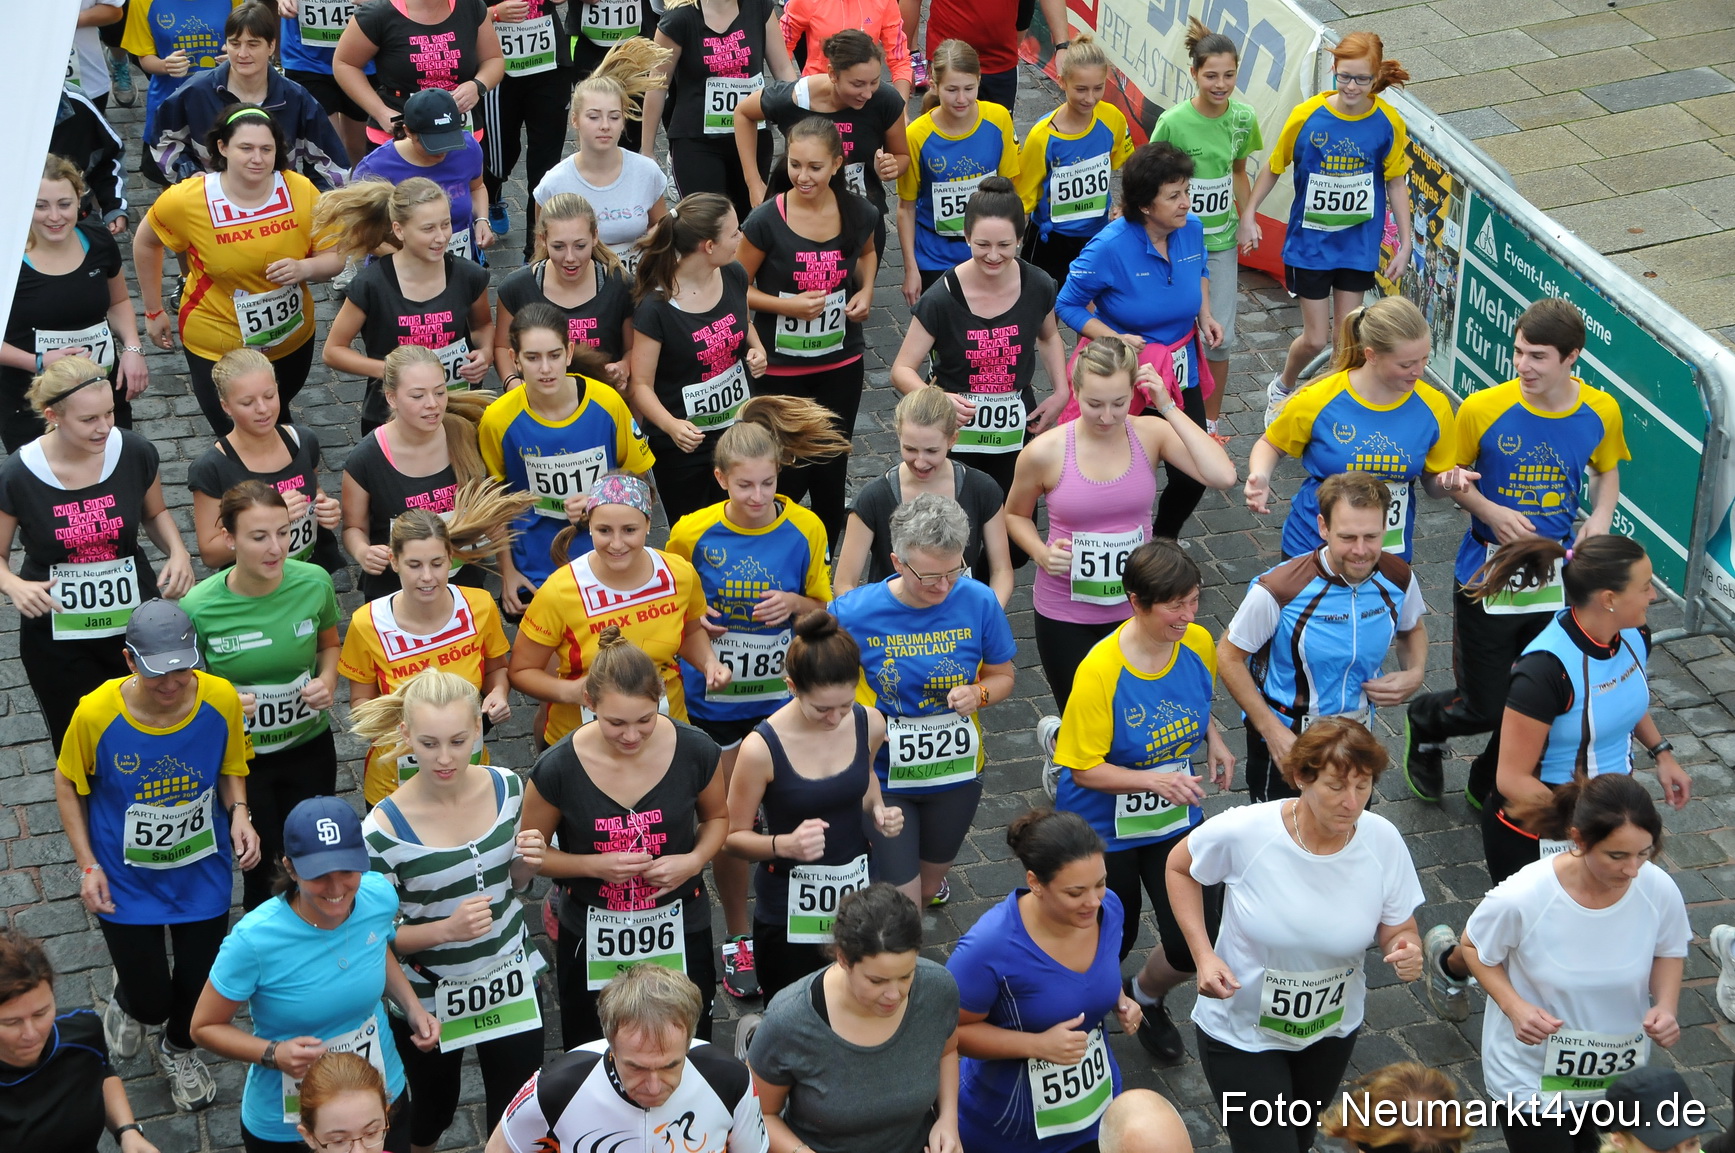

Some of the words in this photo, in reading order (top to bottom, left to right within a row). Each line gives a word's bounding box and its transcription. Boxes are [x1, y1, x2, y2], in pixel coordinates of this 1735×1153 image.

[588, 5, 636, 26] 5110
[516, 24, 544, 32] Neumarkt
[409, 36, 430, 45] WIR
[431, 31, 456, 43] SIND
[501, 30, 550, 56] 5175
[703, 38, 721, 47] WIR
[723, 30, 745, 44] SIND
[420, 42, 449, 53] ZWAR
[713, 41, 740, 54] ZWAR
[410, 52, 441, 63] NICHT
[444, 49, 461, 59] DIE
[510, 57, 543, 69] Angelina
[703, 52, 733, 65] NICHT
[736, 46, 751, 57] DIE
[707, 81, 729, 89] PARTL
[1052, 171, 1074, 180] PARTL
[1074, 162, 1103, 175] Neumarkt
[1058, 169, 1108, 201] 5036
[1196, 182, 1227, 191] Neumarkt
[1310, 179, 1333, 188] PARTL
[1333, 180, 1363, 189] Neumarkt
[1074, 200, 1094, 212] Nina
[1312, 189, 1369, 212] 5502
[215, 229, 254, 245] MAX
[258, 218, 299, 238] BÖGL
[796, 251, 817, 262] WIR
[806, 261, 837, 271] ZWAR
[793, 271, 826, 281] NICHT
[830, 269, 848, 279] DIE
[246, 293, 300, 333] 5139
[398, 315, 421, 326] WIR
[424, 311, 453, 324] SIND
[410, 323, 443, 335] ZWAR
[568, 318, 597, 330] SIND
[692, 326, 712, 343] WIR
[712, 313, 737, 332] SIND
[67, 332, 102, 344] Neumarkt
[398, 334, 433, 346] NICHT
[704, 327, 732, 348] ZWAR
[728, 331, 744, 346] DIE
[967, 330, 989, 340] WIR
[992, 325, 1019, 338] SIND
[1465, 316, 1492, 361] für
[802, 338, 822, 349] Lisa
[978, 337, 1009, 349] ZWAR
[966, 348, 999, 359] NICHT
[1003, 344, 1021, 356] DIE
[979, 365, 1008, 375] ABER
[684, 388, 709, 400] PARTL
[709, 372, 736, 392] Neumarkt
[969, 373, 1016, 384] BESSERE
[694, 378, 744, 415] 5008
[983, 394, 1016, 402] Neumarkt
[707, 411, 731, 426] Viola
[977, 434, 1002, 445] Julia
[526, 461, 553, 470] PARTL
[554, 456, 593, 470] Neumarkt
[277, 474, 305, 494] SIND
[535, 464, 601, 496] 5017
[53, 502, 80, 517] WIR
[83, 494, 116, 512] SIND
[405, 492, 431, 508] WIR
[68, 509, 107, 526] ZWAR
[1612, 508, 1636, 539] 352
[55, 522, 97, 540] NICHT
[100, 516, 124, 532] DIE
[1074, 538, 1101, 548] PARTL
[1103, 537, 1138, 548] Neumarkt
[52, 570, 82, 578] PARTL
[83, 567, 122, 578] Neumarkt
[61, 577, 133, 610] 5030
[1103, 585, 1122, 595] Lea
[84, 616, 112, 628] Jana
[589, 614, 632, 635] MAX
[636, 601, 679, 623] BÖGL
[711, 638, 741, 648] PARTL
[867, 636, 885, 648] 10.
[886, 627, 973, 646] NEUMARKTER
[885, 641, 957, 658] STADTLAUF
[391, 659, 431, 680] MAX
[438, 643, 480, 667] BÖGL
[718, 650, 786, 678] 5183
[733, 682, 764, 694] Laura
[889, 723, 919, 732] PARTL
[921, 719, 959, 732] Neumarkt
[260, 730, 293, 744] Maria
[899, 727, 971, 763] 5529
[896, 760, 956, 779] URSULA
[135, 807, 205, 847] 5218
[595, 816, 623, 831] WIR
[627, 809, 663, 824] SIND
[316, 818, 341, 846] SD
[609, 824, 650, 841] ZWAR
[594, 838, 637, 851] NICHT
[641, 833, 667, 846] DIE
[152, 844, 192, 862] Sabine
[824, 868, 861, 882] Neumarkt
[599, 887, 625, 901] WIR
[589, 913, 621, 924] PARTL
[597, 922, 675, 957] 5096
[1265, 976, 1299, 987] PARTL
[1302, 973, 1343, 988] Neumarkt
[447, 969, 524, 1017] 5080
[1271, 981, 1346, 1019] 5074
[474, 1013, 501, 1030] Lisa
[1283, 1018, 1325, 1036] Claudia
[1550, 1035, 1585, 1047] PARTL
[1587, 1039, 1632, 1049] Neumarkt
[1556, 1048, 1637, 1076] 5033
[1042, 1047, 1105, 1105] 5509
[1571, 1079, 1605, 1088] Anita
